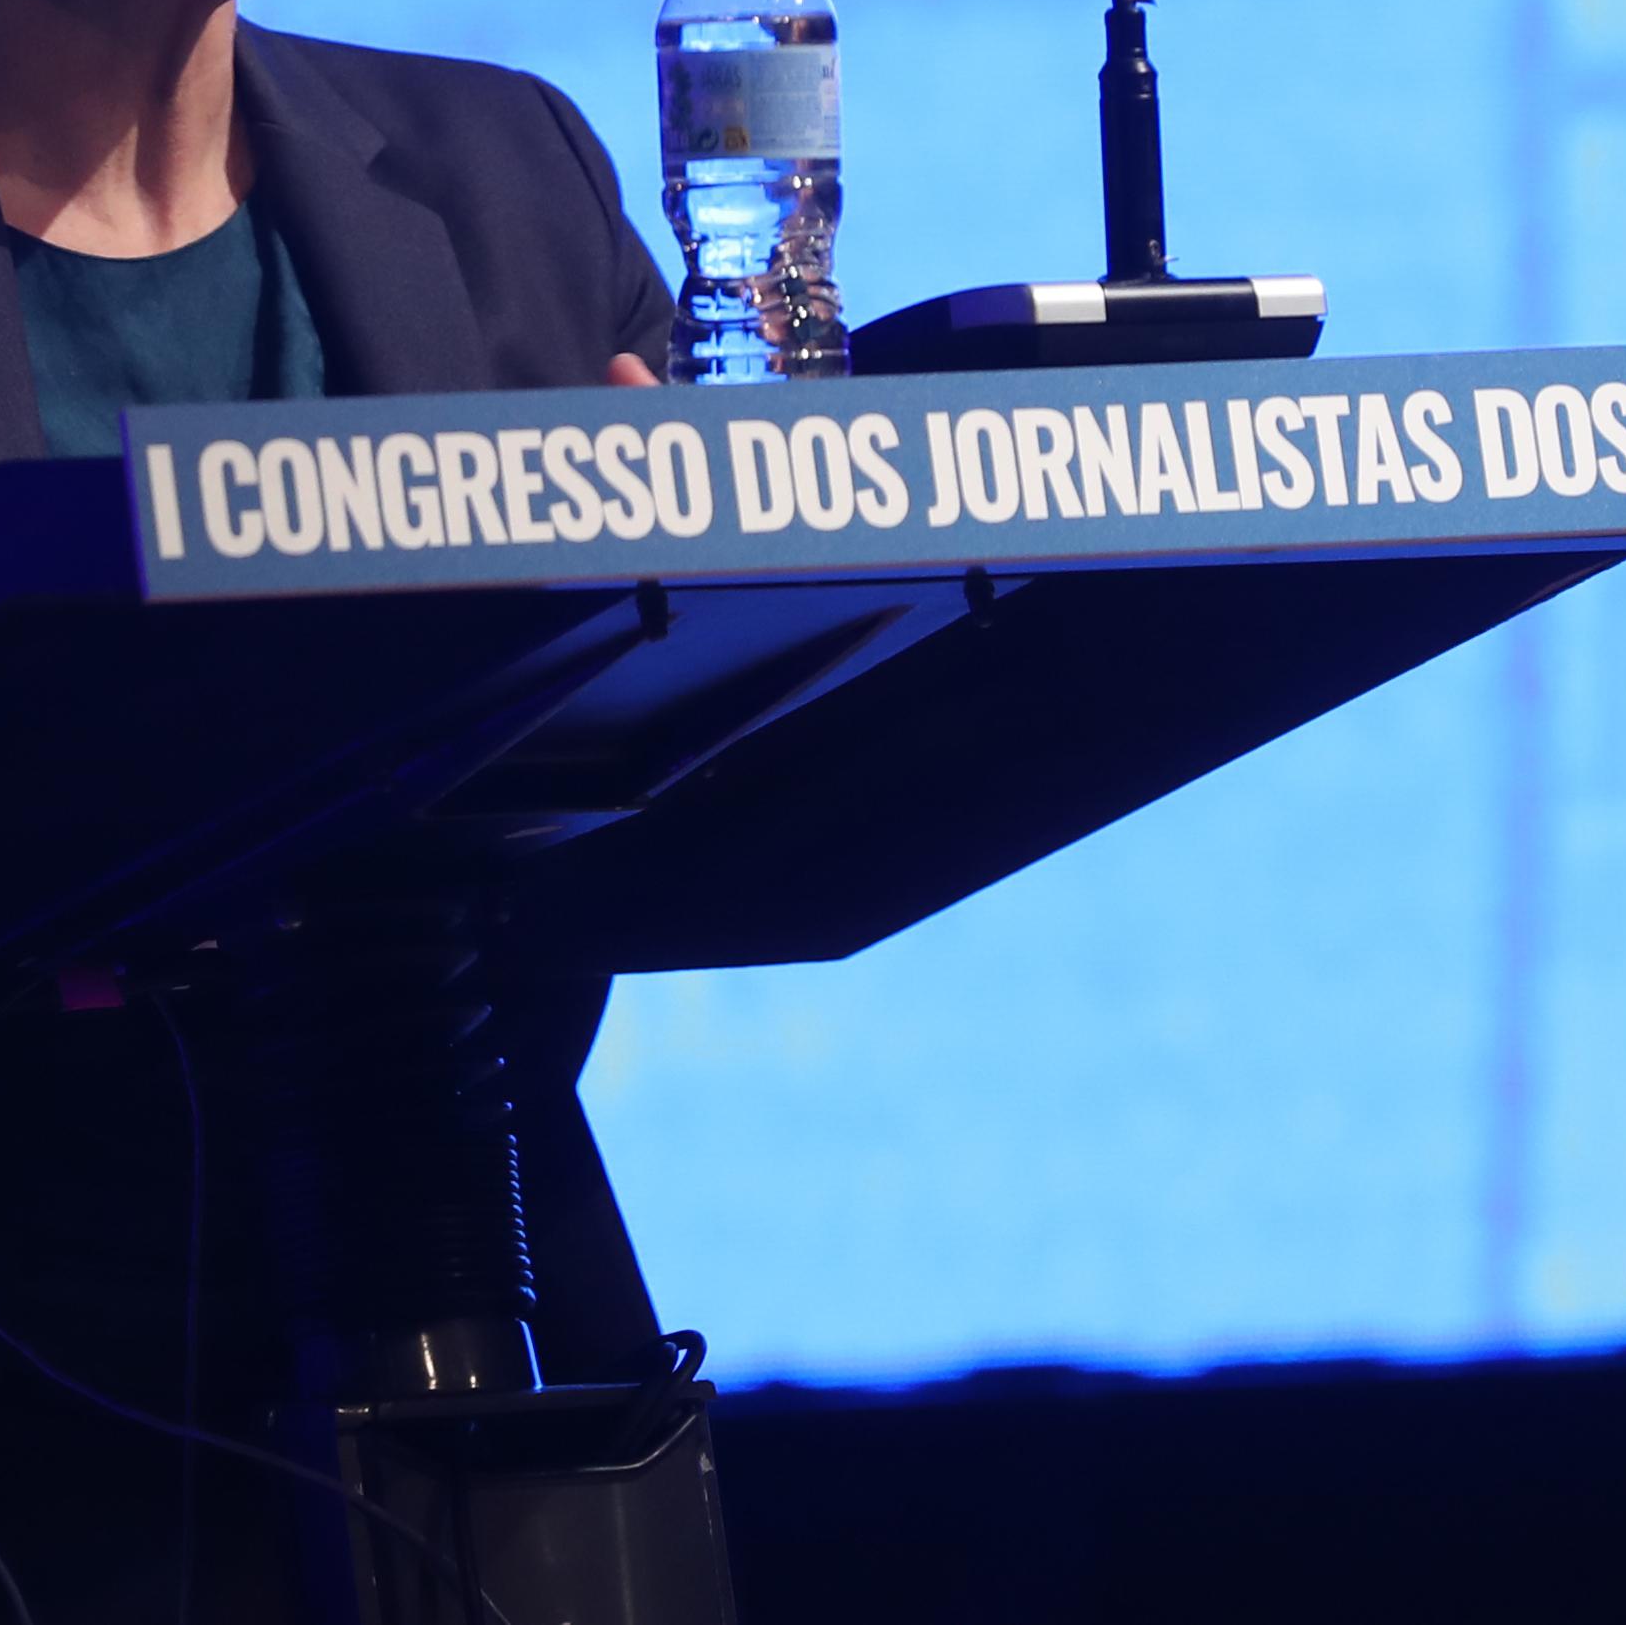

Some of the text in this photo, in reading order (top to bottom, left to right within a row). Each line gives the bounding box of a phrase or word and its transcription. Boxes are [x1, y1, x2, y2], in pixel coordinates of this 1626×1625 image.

[145, 443, 185, 560] I
[198, 420, 714, 560] CONGRESSO
[726, 412, 911, 534] DOS
[926, 388, 1464, 528] JORNALISTAS
